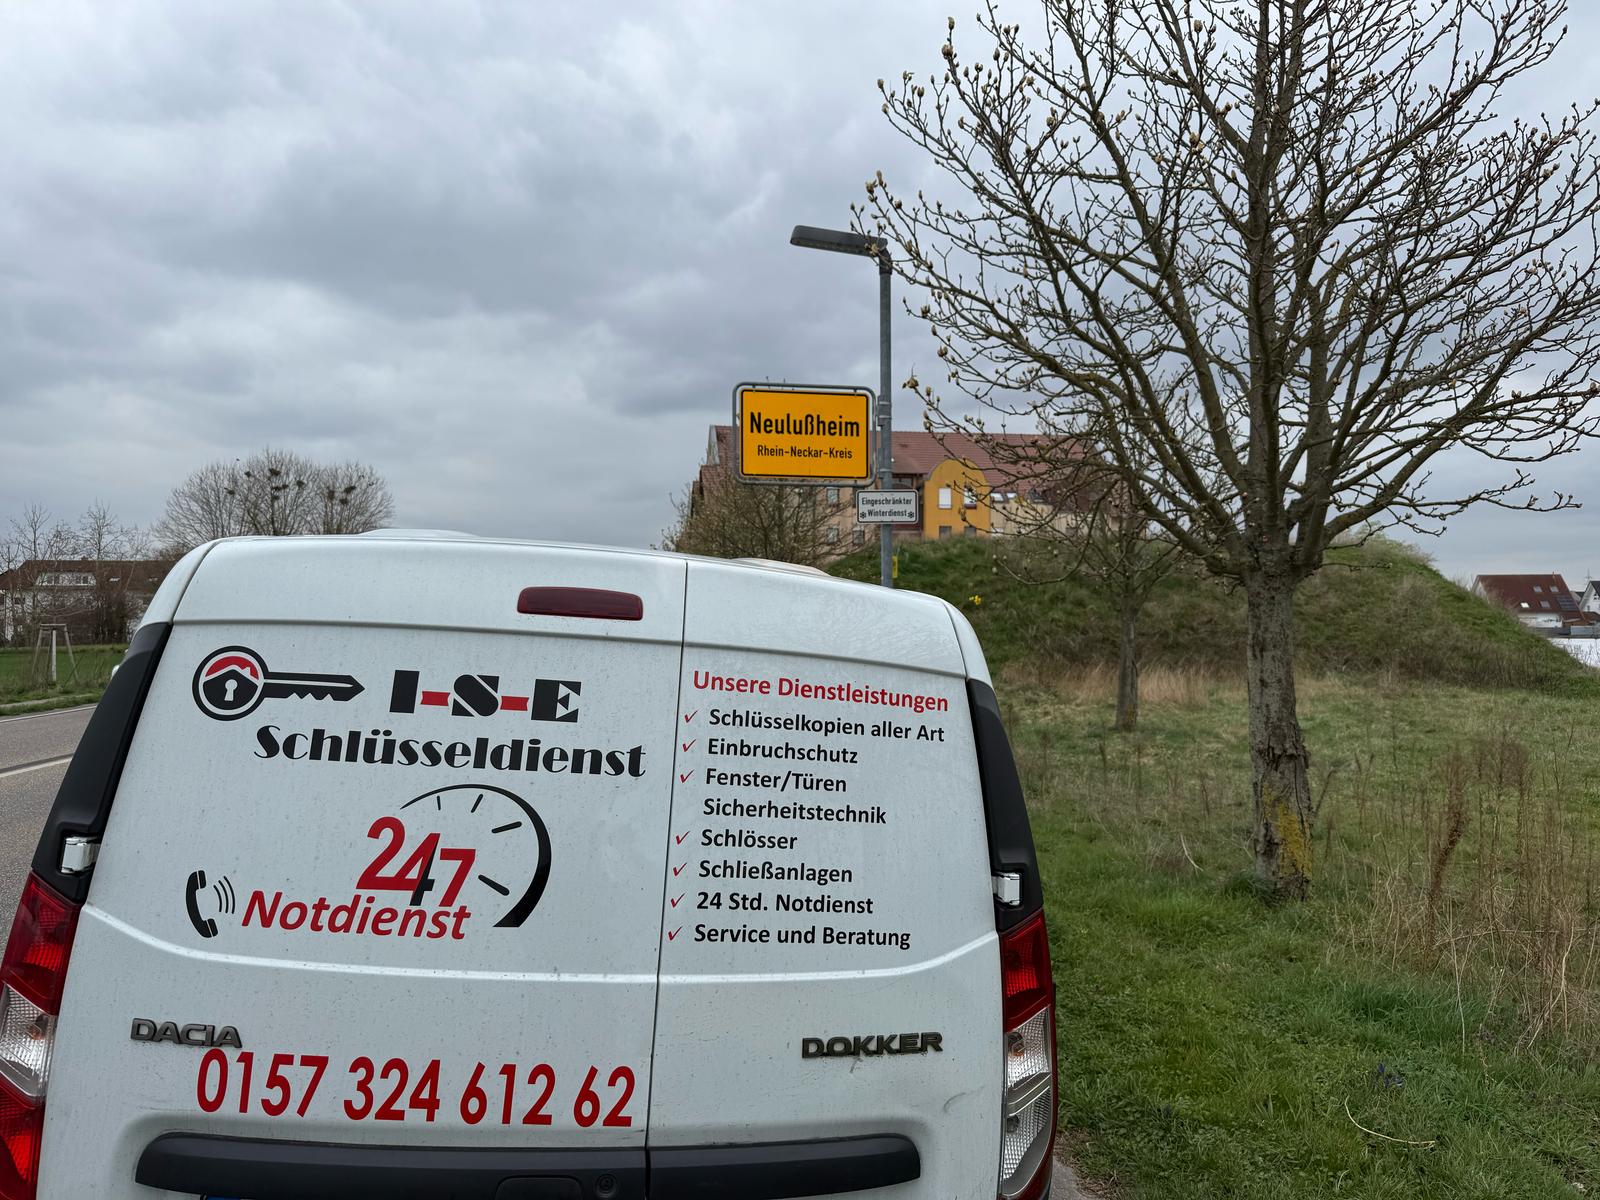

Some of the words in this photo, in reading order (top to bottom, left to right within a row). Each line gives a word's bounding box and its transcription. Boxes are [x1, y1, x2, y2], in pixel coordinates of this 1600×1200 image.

[750, 411, 860, 437] Neulußheim
[757, 444, 853, 459] Rhein-Neckar-Kreis
[861, 496, 912, 506] Eingeschränkter
[867, 508, 908, 517] Winterdienst
[389, 669, 582, 723] I-S-E
[693, 670, 771, 694] Unsere
[778, 677, 949, 713] Dienstleistungen
[708, 708, 865, 737] Schlüsselkopien
[870, 720, 912, 739] aller
[916, 724, 945, 742] Art
[253, 724, 647, 777] Schlüsseldienst
[707, 738, 858, 764] Einbruchschutz
[705, 768, 847, 792] Fenster/Türen
[703, 798, 887, 824] Sicherheitstechnik
[700, 828, 798, 850] Schlösser
[698, 860, 853, 886] Schließanlagen
[241, 889, 472, 940] Notdienst
[696, 891, 722, 910] 24
[728, 892, 769, 911] Std.
[775, 893, 874, 914] Notdienst
[694, 923, 770, 944] Service
[776, 926, 816, 945] und
[822, 926, 911, 950] Beratung
[130, 1017, 243, 1049] DACIA
[801, 1031, 944, 1059] DOKKER
[196, 1048, 330, 1118] 0157
[343, 1056, 442, 1123] 324
[459, 1061, 557, 1126] 612
[572, 1065, 637, 1128] 62
